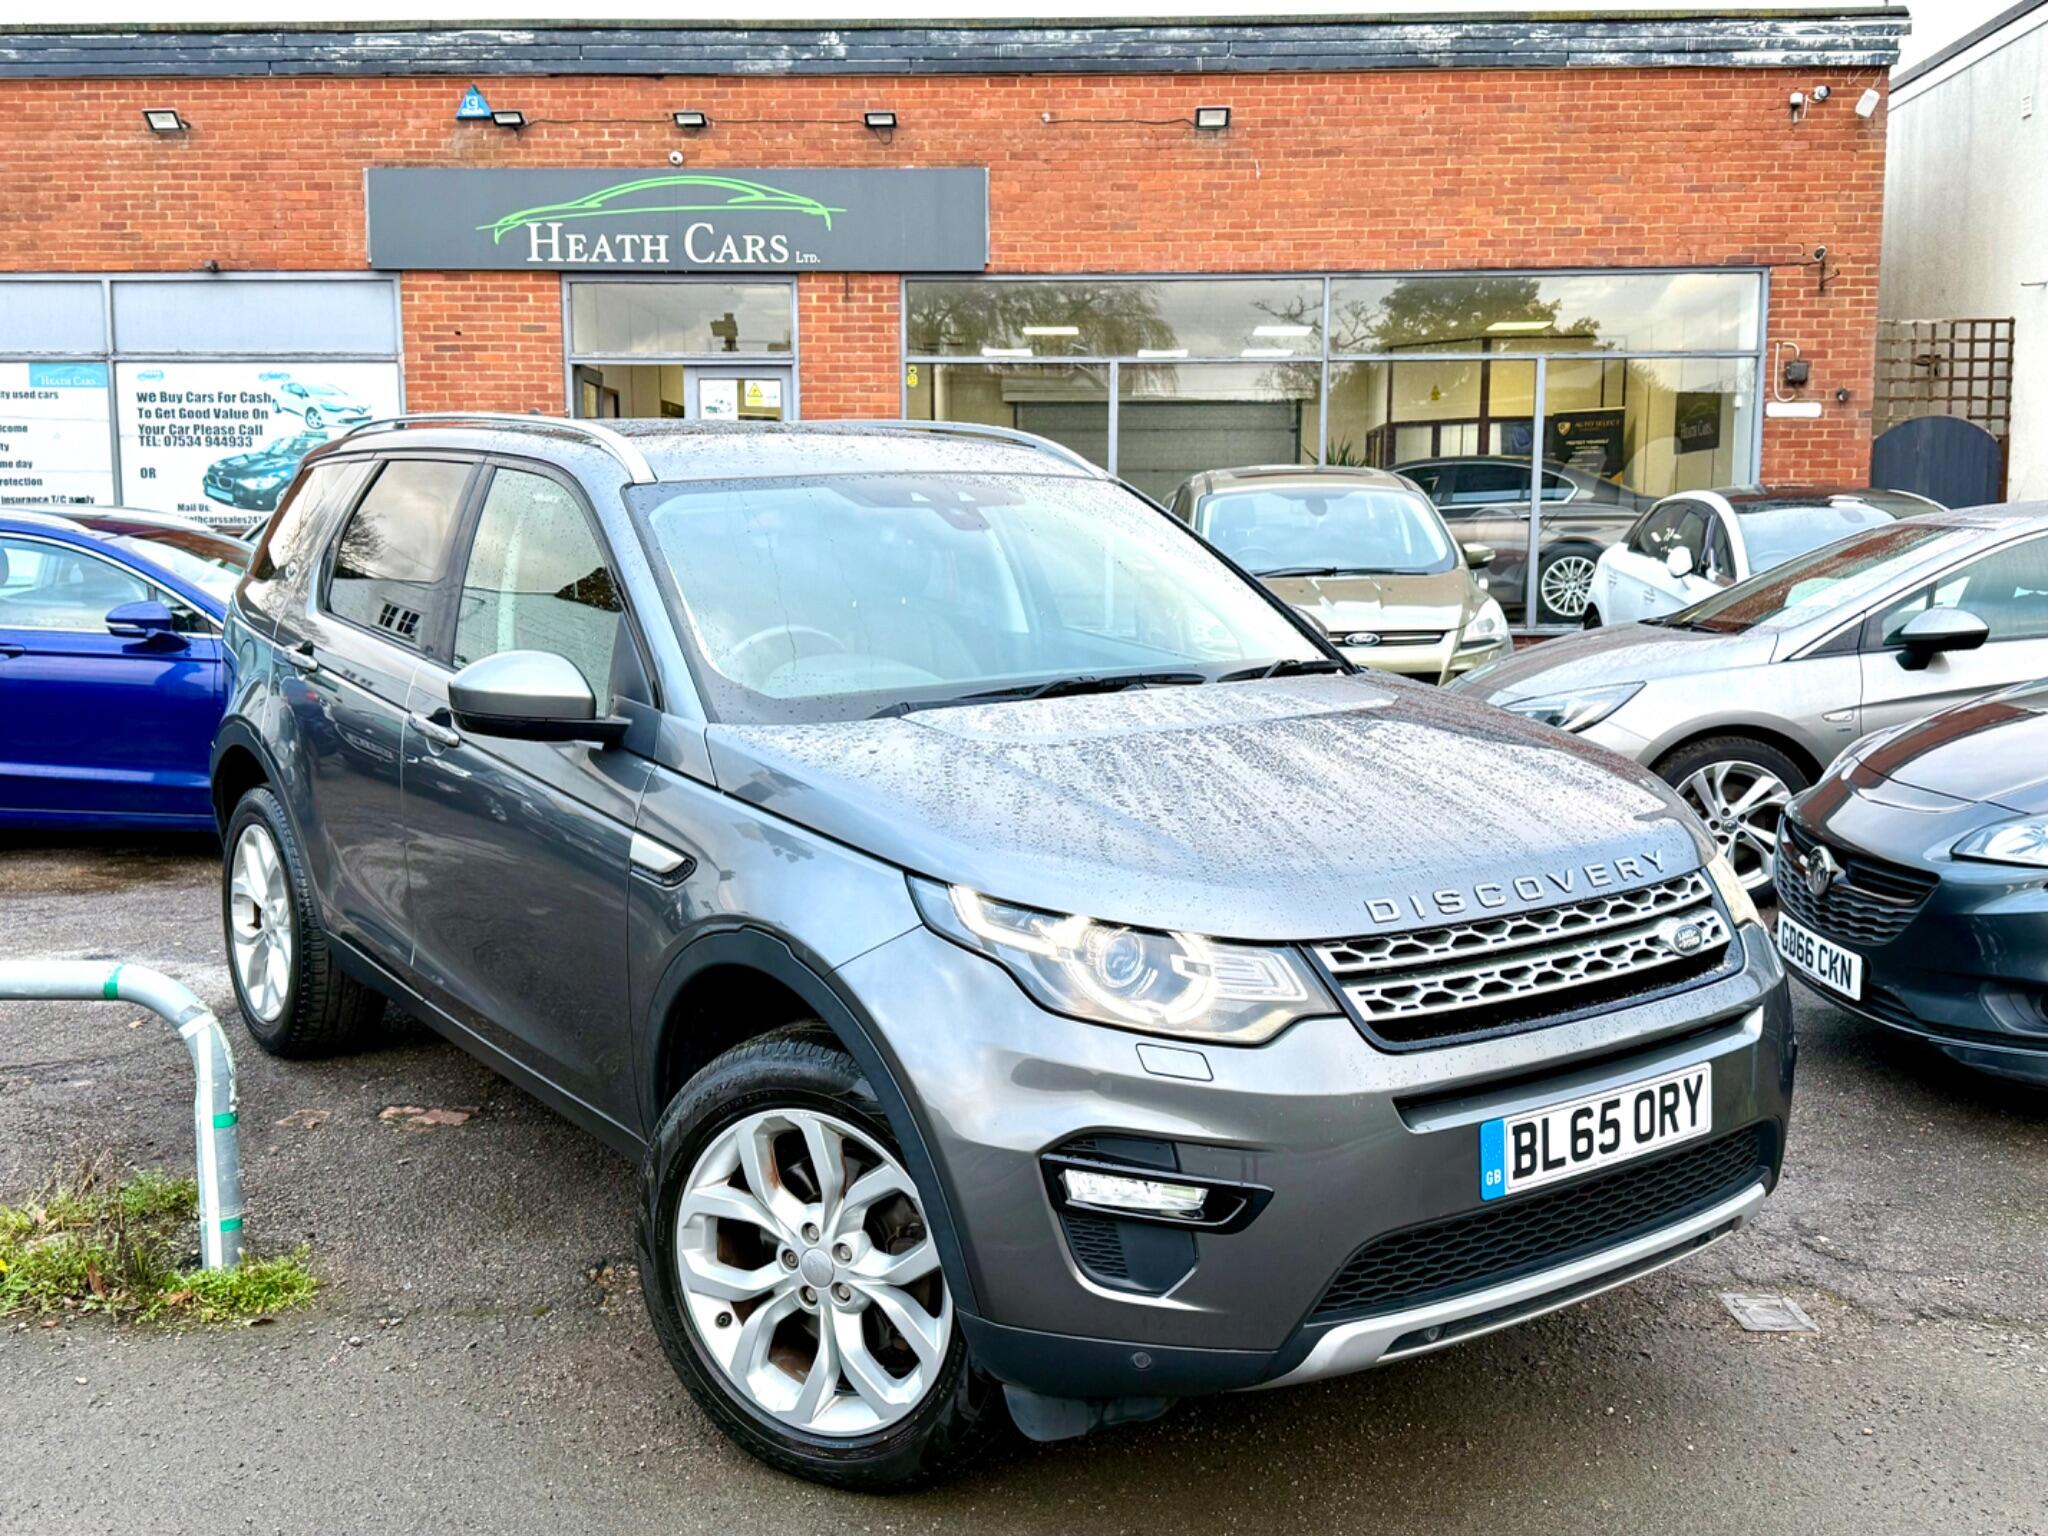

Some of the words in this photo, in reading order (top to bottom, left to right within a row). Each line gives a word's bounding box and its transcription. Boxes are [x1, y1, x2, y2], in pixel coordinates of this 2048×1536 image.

[525, 222, 669, 263] HEATH
[684, 222, 789, 264] CARS
[12, 390, 35, 399] used
[38, 391, 59, 399] cars
[160, 392, 182, 403] Buy
[186, 392, 214, 403] Cars
[218, 392, 237, 403] For
[138, 407, 152, 419] To
[155, 408, 175, 419] Get
[179, 407, 210, 419] Good
[213, 408, 249, 419] Value
[252, 408, 269, 419] On
[138, 424, 165, 435] Your
[168, 424, 190, 435] Car
[193, 424, 235, 435] Please
[239, 424, 263, 435] Call
[164, 435, 201, 447] 07534
[205, 435, 253, 447] 944933
[16, 460, 32, 469] day
[140, 467, 156, 479] OR
[177, 504, 197, 512] Mail
[1364, 849, 1665, 924] DISCOVERY
[1781, 921, 1814, 969] GD66
[1818, 943, 1852, 990] CKN
[1512, 1098, 1620, 1180] BL65
[1634, 1074, 1703, 1145] ORY
[1486, 1168, 1502, 1187] GB
